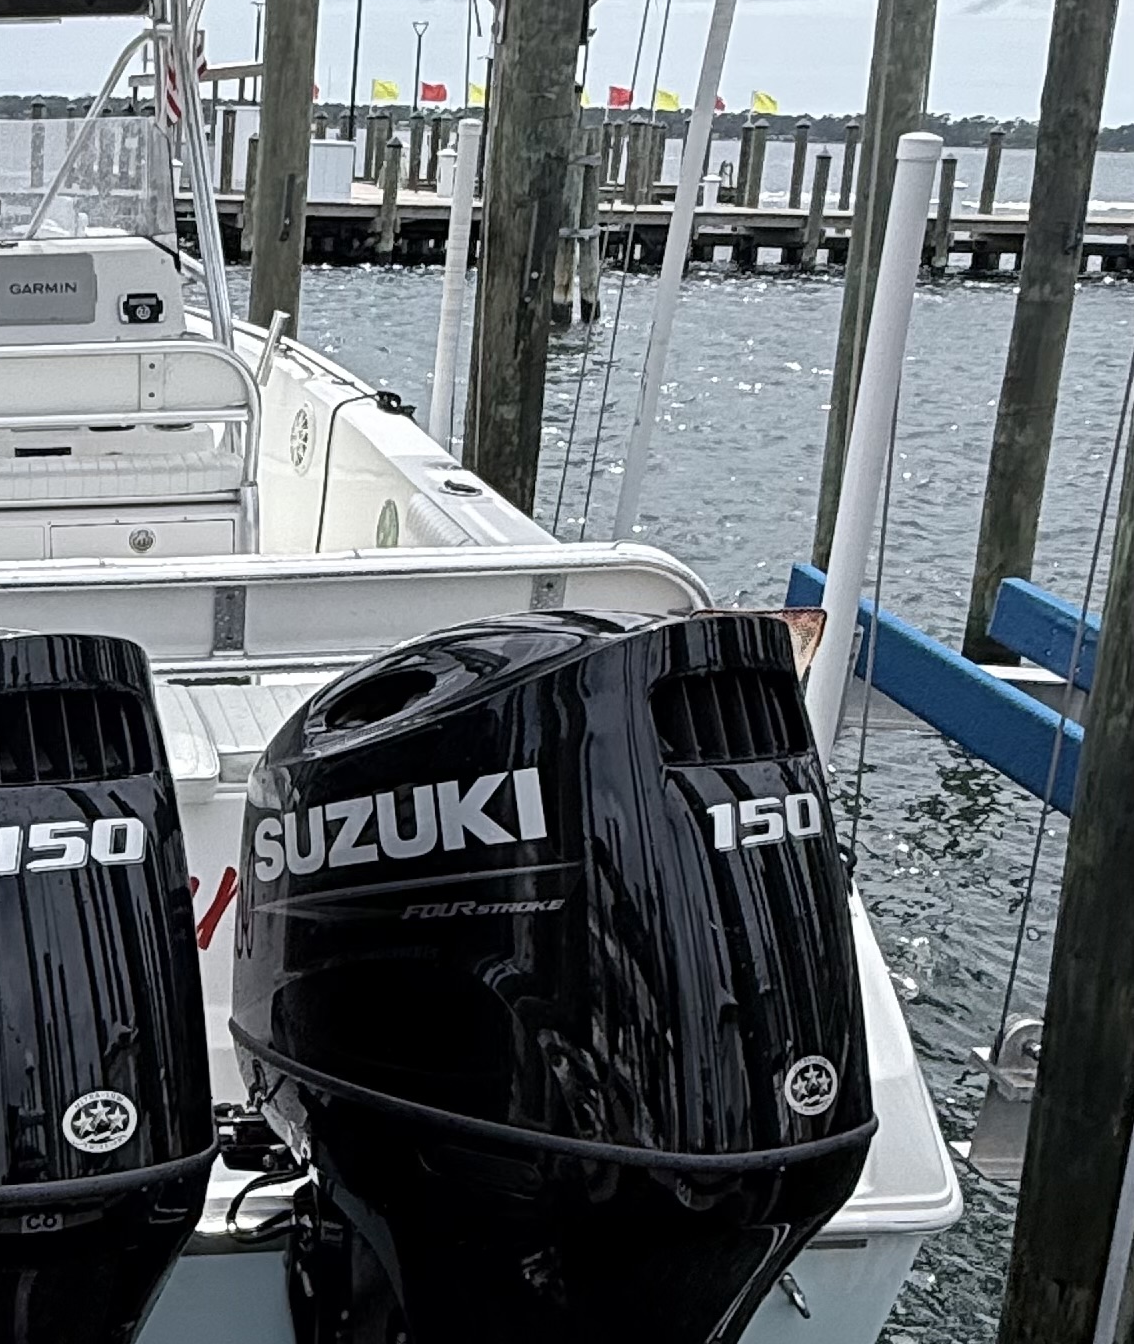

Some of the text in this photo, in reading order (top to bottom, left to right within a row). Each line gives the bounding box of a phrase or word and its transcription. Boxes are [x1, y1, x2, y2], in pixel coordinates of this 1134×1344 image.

[9, 282, 77, 295] GARMIN
[254, 767, 547, 882] SUZUKI
[706, 793, 823, 853] 150
